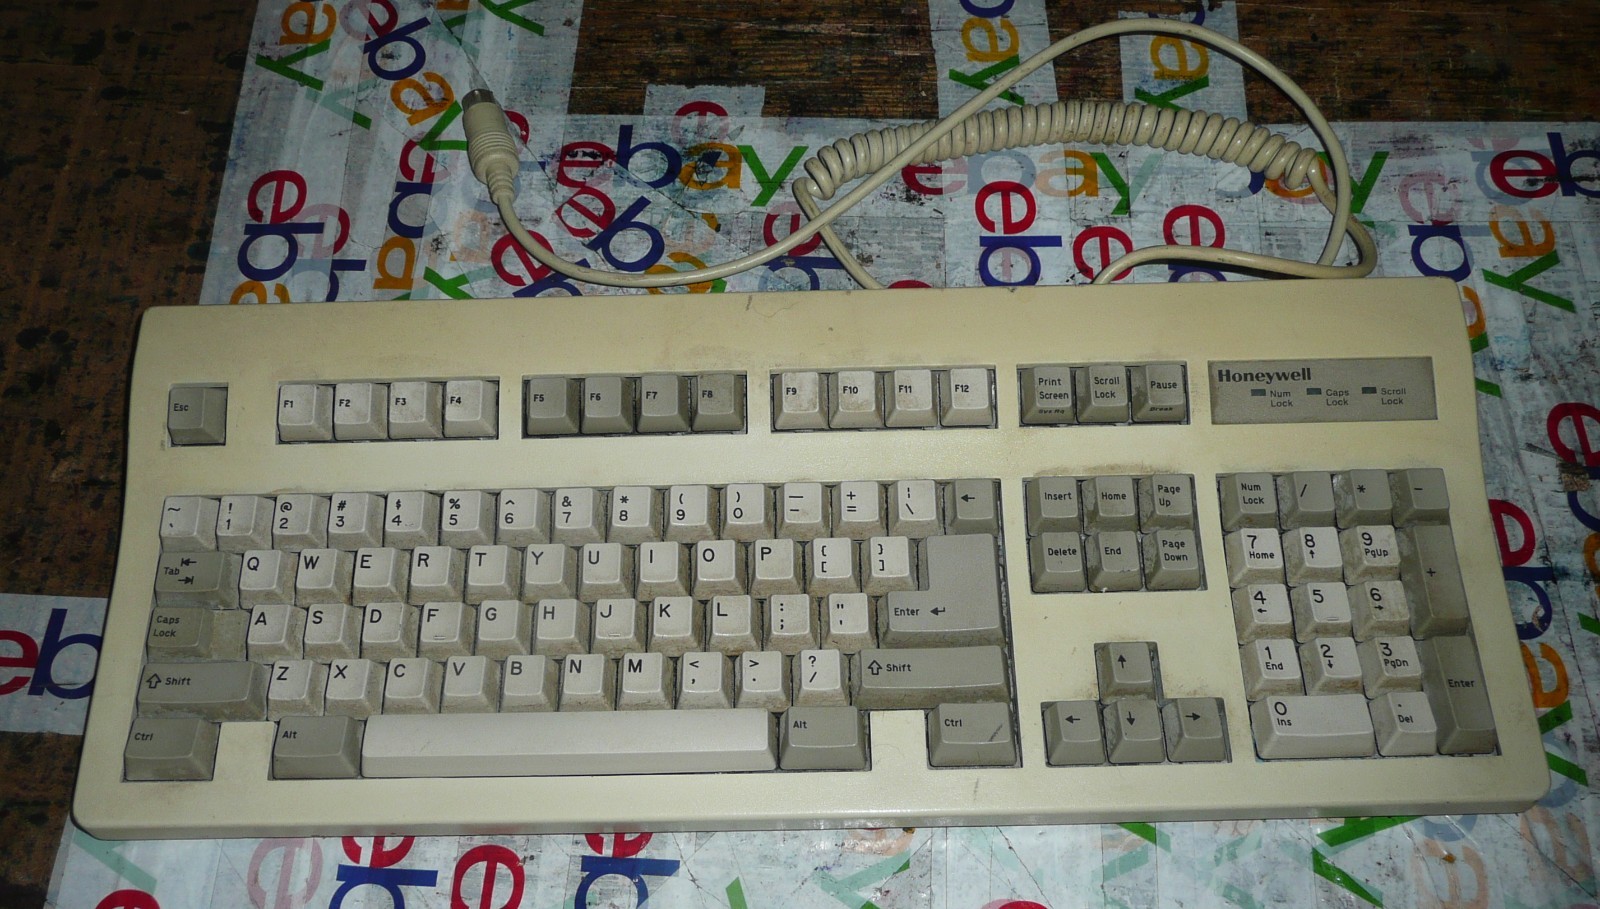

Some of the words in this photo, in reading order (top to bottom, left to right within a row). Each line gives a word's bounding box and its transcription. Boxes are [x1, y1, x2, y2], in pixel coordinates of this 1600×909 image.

[556, 125, 809, 207] ebay
[1489, 132, 1600, 198] eb
[974, 180, 1063, 286] eb
[1218, 368, 1311, 384] Honeywell
[1039, 378, 1061, 386] Print
[1151, 381, 1177, 389] Pause
[786, 387, 797, 395] F9
[843, 386, 858, 394] F10
[899, 385, 911, 393] F11
[955, 384, 969, 392] F12
[1326, 389, 1349, 397] Caps
[534, 394, 544, 402] F5
[590, 393, 601, 401] F6
[646, 391, 657, 399] F7
[702, 390, 713, 398] F8
[1040, 391, 1068, 399] Screen
[1095, 390, 1115, 398] Lock
[174, 403, 188, 411] Esc
[284, 400, 293, 408] F1
[339, 399, 350, 407] F2
[1326, 398, 1348, 406] Lock
[1158, 485, 1180, 494] Page
[1241, 483, 1261, 491] Num
[562, 496, 572, 507] &
[1045, 492, 1072, 500] Insert
[1102, 492, 1126, 500] Home
[1243, 496, 1264, 504] Lock
[280, 502, 292, 512] @
[337, 501, 346, 511] #
[396, 499, 401, 510] $
[449, 499, 460, 509] %
[1159, 498, 1170, 507] Up
[449, 514, 457, 525] 5
[505, 513, 513, 524] 6
[563, 512, 571, 523] 7
[619, 510, 628, 521] 8
[677, 509, 685, 520] 9
[226, 519, 230, 530] 1
[279, 518, 288, 529] 2
[336, 516, 344, 527] 3
[392, 515, 402, 526] 4
[1162, 540, 1185, 549] Page
[1247, 535, 1257, 549] 7
[1305, 534, 1315, 548] 8
[1362, 532, 1372, 546] 9
[650, 550, 653, 563] I
[703, 549, 714, 562] O
[761, 547, 771, 560] P
[1048, 548, 1076, 556] Delete
[1105, 547, 1121, 555] End
[1249, 551, 1274, 559] Home
[1365, 548, 1388, 558] PgUp
[304, 556, 319, 569] W
[360, 555, 372, 568] E
[418, 553, 429, 567] R
[475, 553, 486, 566] T
[532, 551, 543, 565] Y
[589, 551, 599, 564] U
[1164, 553, 1188, 561] Down
[247, 557, 259, 571] Q
[164, 567, 179, 575] Tab
[1254, 591, 1266, 604] 4
[1313, 589, 1323, 603] 5
[1370, 588, 1382, 601] 6
[485, 607, 496, 621] G
[544, 606, 554, 619] H
[600, 605, 612, 618] J
[660, 604, 670, 617] K
[717, 602, 728, 616] L
[894, 608, 919, 616] Enter
[157, 616, 180, 625] Caps
[255, 612, 266, 625] A
[313, 611, 323, 624] S
[370, 609, 382, 623] D
[427, 609, 439, 622] F
[153, 629, 176, 637] Lock
[0, 608, 103, 700] eb
[1265, 646, 1272, 659] 1
[1321, 644, 1333, 658] 2
[1380, 643, 1392, 656] 3
[570, 660, 581, 673] N
[628, 659, 642, 673] M
[809, 656, 816, 667] ?
[1266, 662, 1283, 670] End
[1384, 659, 1408, 669] PgDn
[277, 666, 289, 680] Z
[334, 665, 348, 679] X
[394, 664, 405, 677] C
[453, 662, 465, 676] V
[511, 661, 522, 675] B
[1448, 679, 1474, 687] Enter
[945, 719, 962, 727] Ctrl
[1277, 718, 1292, 726] Ins
[1398, 715, 1413, 723] Del
